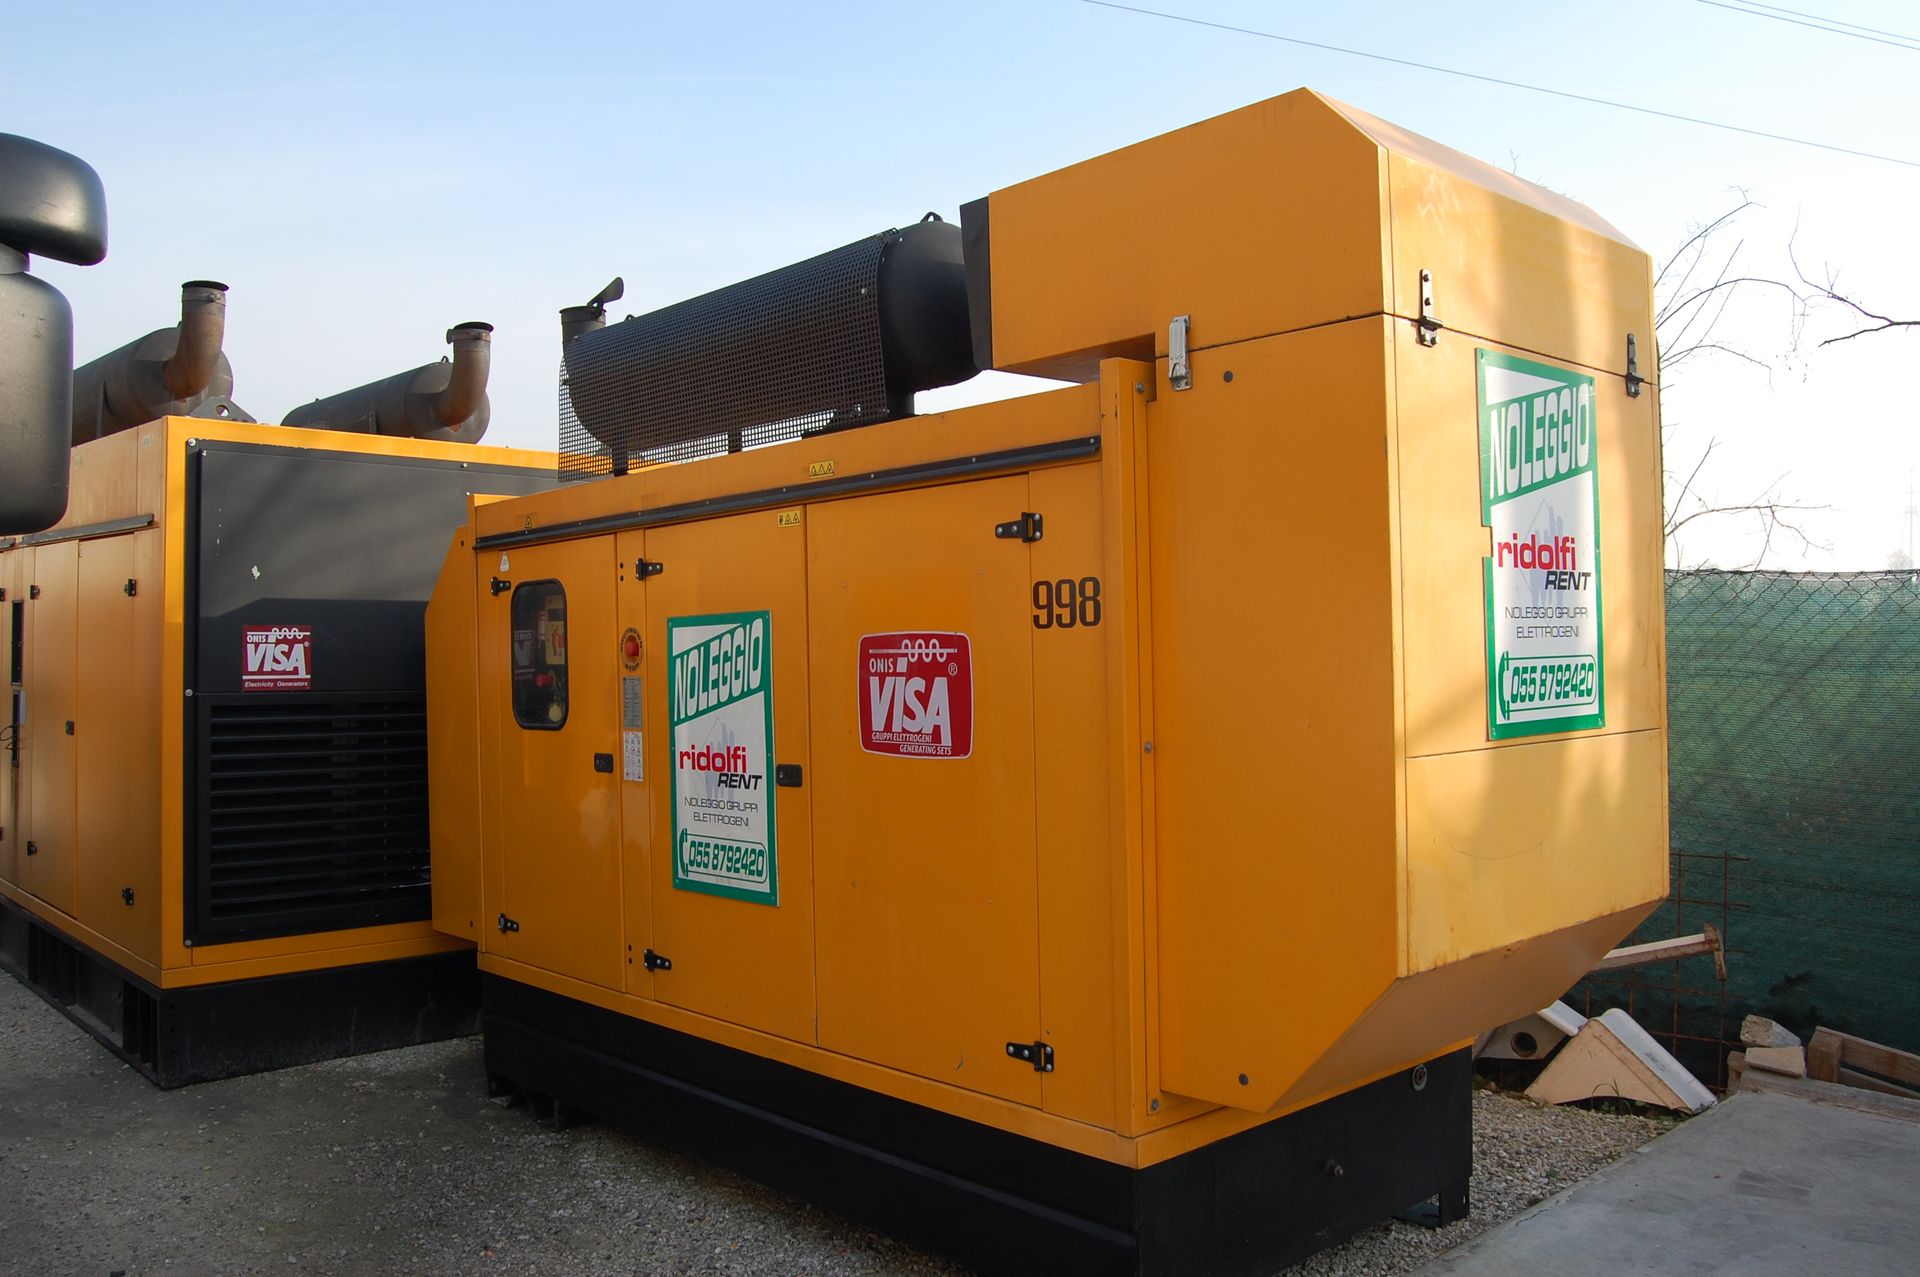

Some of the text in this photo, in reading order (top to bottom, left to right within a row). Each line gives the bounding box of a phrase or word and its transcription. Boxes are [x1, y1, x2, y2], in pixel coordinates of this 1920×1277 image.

[1489, 383, 1590, 500] NOLEGGIO
[1498, 533, 1576, 570] ridolfi
[1545, 570, 1591, 590] RENT
[1033, 576, 1101, 629] 998
[1505, 606, 1588, 619] NOLEGGIO GRUPPI
[246, 634, 266, 643] ONIS
[1516, 625, 1579, 638] ELETTROGENI
[246, 634, 307, 678] VISA
[869, 658, 894, 673] ONIS
[674, 618, 763, 722] NOLEGGIO
[1511, 662, 1594, 704] 055 8792420
[869, 657, 952, 746] VISA
[871, 731, 932, 743] GRUPPI ELETTROGENI
[679, 744, 747, 773] ridolfi
[899, 744, 952, 756] GENERATING SETS
[717, 772, 762, 790] RENT
[684, 796, 758, 813] NOLEGGIO GRUPPI
[693, 811, 749, 827] ELETTROGENI
[688, 840, 765, 877] 055 8792420
